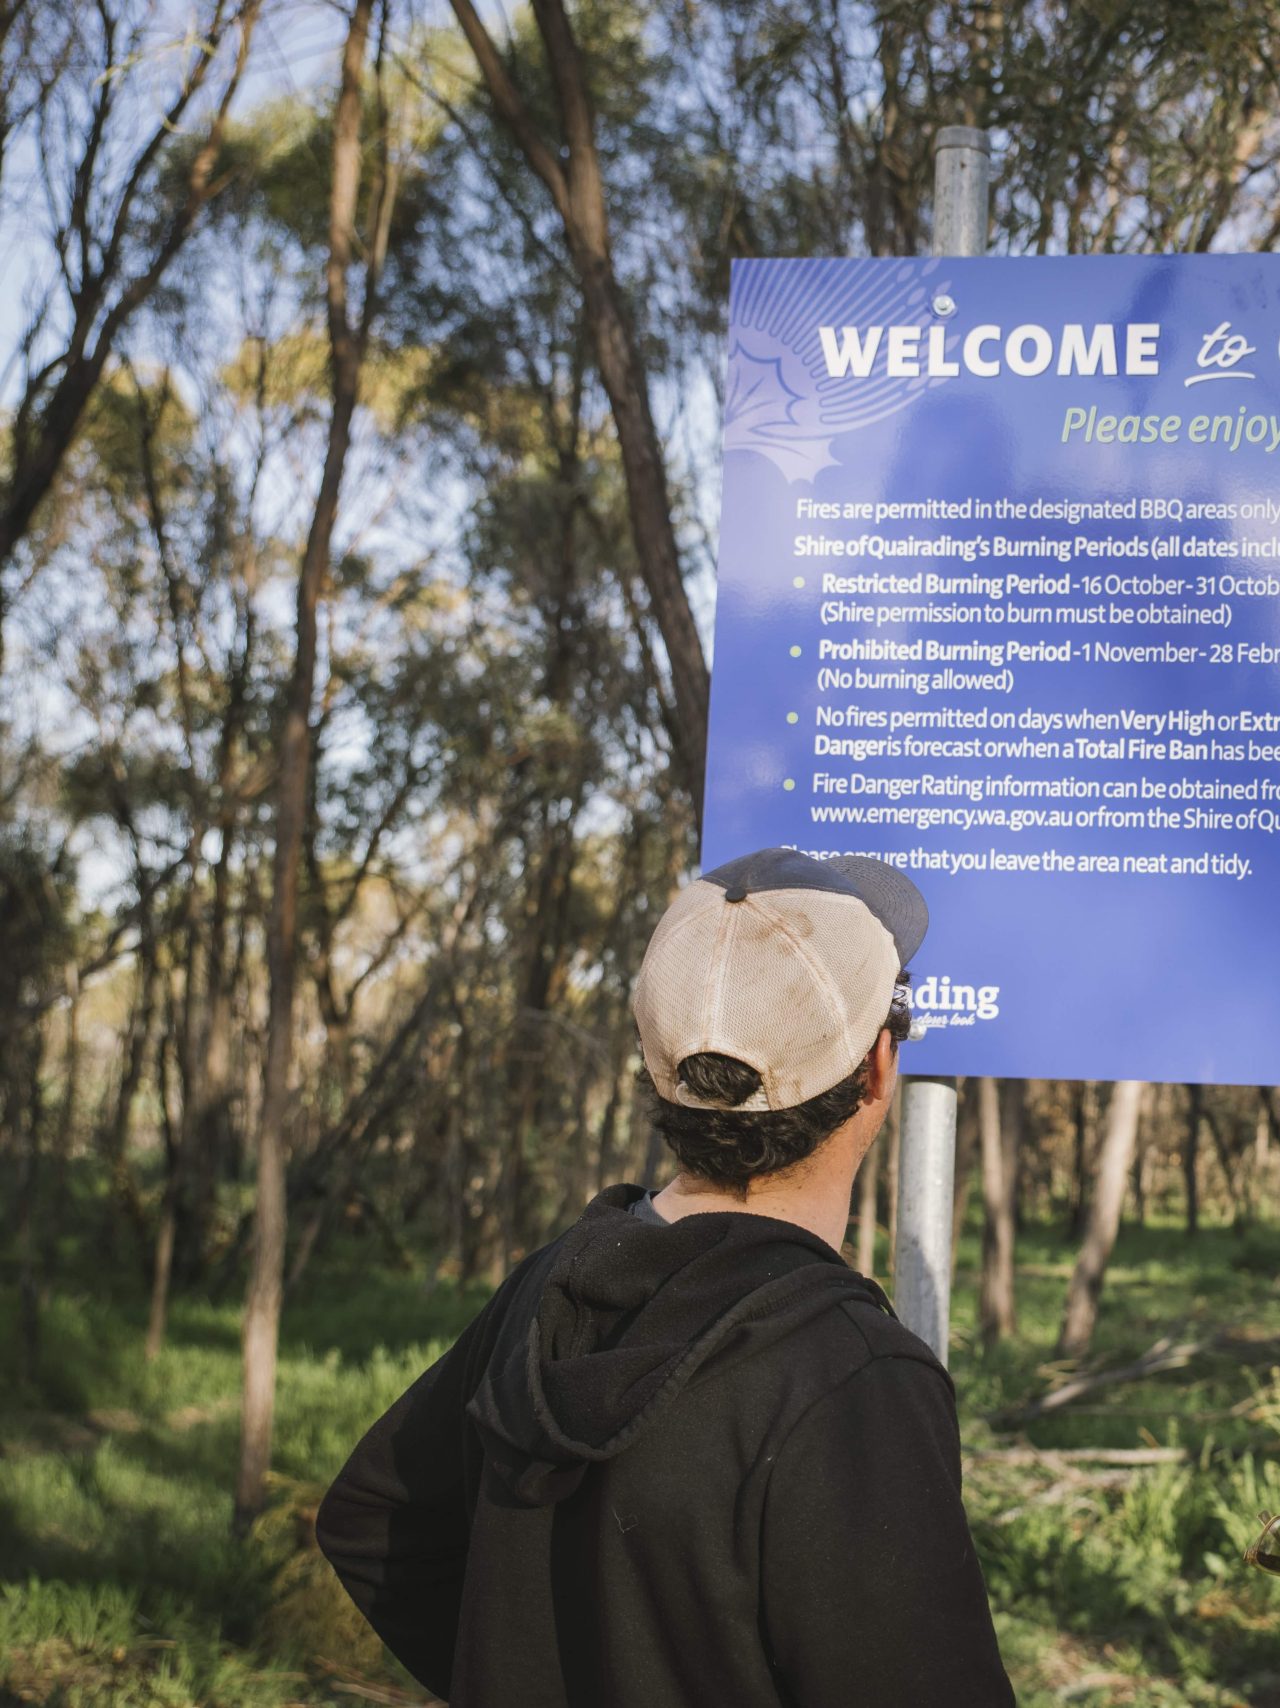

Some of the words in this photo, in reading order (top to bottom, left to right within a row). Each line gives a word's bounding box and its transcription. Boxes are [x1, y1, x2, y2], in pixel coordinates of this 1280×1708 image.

[818, 323, 1160, 378] WELCOME
[1196, 321, 1257, 369] to
[1061, 406, 1182, 443] Please
[797, 499, 840, 518] Fires
[843, 504, 873, 518] are
[876, 498, 971, 523] permitted
[976, 499, 992, 518] in
[995, 498, 1027, 518] the
[1030, 498, 1136, 524] designated
[1141, 499, 1183, 522] BBQ
[1186, 504, 1236, 519] areas
[794, 535, 851, 556] Shire
[849, 535, 870, 555] of
[868, 535, 990, 561] Quairading's
[994, 536, 1072, 561] Burning
[1075, 536, 1148, 556] Periods
[1151, 536, 1179, 560] (all
[1183, 536, 1237, 557] dates
[823, 573, 922, 593] Restricted
[926, 574, 1004, 599] Burning
[1006, 574, 1070, 594] Period
[1105, 574, 1185, 594] October
[1196, 577, 1215, 595] 31
[821, 601, 874, 625] (Shire
[878, 603, 981, 626] permission
[984, 604, 1004, 622] to
[1008, 602, 1052, 622] burn
[1056, 605, 1106, 623] must
[1110, 603, 1134, 623] be
[1137, 603, 1232, 627] obtained)
[820, 639, 922, 660] Prohibited
[926, 640, 1004, 666] Burning
[1007, 641, 1070, 661] Period
[1095, 642, 1198, 662] November
[1210, 644, 1233, 662] 28
[818, 668, 852, 691] (No
[855, 668, 930, 694] burning
[932, 669, 1013, 693] allowed)
[816, 706, 844, 726] No
[846, 705, 887, 727] fires
[890, 707, 987, 732] permitted
[990, 713, 1015, 728] on
[1019, 708, 1062, 734] days
[1065, 709, 1119, 729] when
[1121, 710, 1166, 735] Very
[1169, 710, 1214, 736] High
[1218, 716, 1238, 731] or
[815, 735, 887, 760] Danger
[887, 738, 901, 756] is
[904, 735, 981, 757] forecast
[984, 742, 1005, 757] or
[1004, 737, 1059, 757] when
[1063, 743, 1073, 758] a
[1075, 738, 1124, 759] Total
[1129, 739, 1165, 759] Fire
[1170, 740, 1207, 759] Ban
[1212, 739, 1244, 760] has
[813, 773, 848, 793] Fire
[851, 774, 920, 799] Danger
[922, 775, 984, 801] Rating
[986, 775, 1099, 797] information
[1103, 782, 1137, 798] can
[1142, 778, 1166, 798] be
[1169, 778, 1257, 799] obtained
[811, 807, 1072, 830] www.emergency.wa.gov.au
[1076, 811, 1099, 826] or
[1098, 806, 1144, 827] from
[1147, 807, 1180, 828] the
[1184, 808, 1232, 829] Shire
[1236, 809, 1259, 829] of
[910, 847, 949, 869] that
[950, 854, 986, 875] you
[990, 848, 1040, 870] leave
[1042, 850, 1075, 871] the
[1078, 856, 1119, 872] area
[1124, 854, 1168, 873] neat
[1171, 853, 1208, 873] and
[1211, 853, 1252, 880] tidy.
